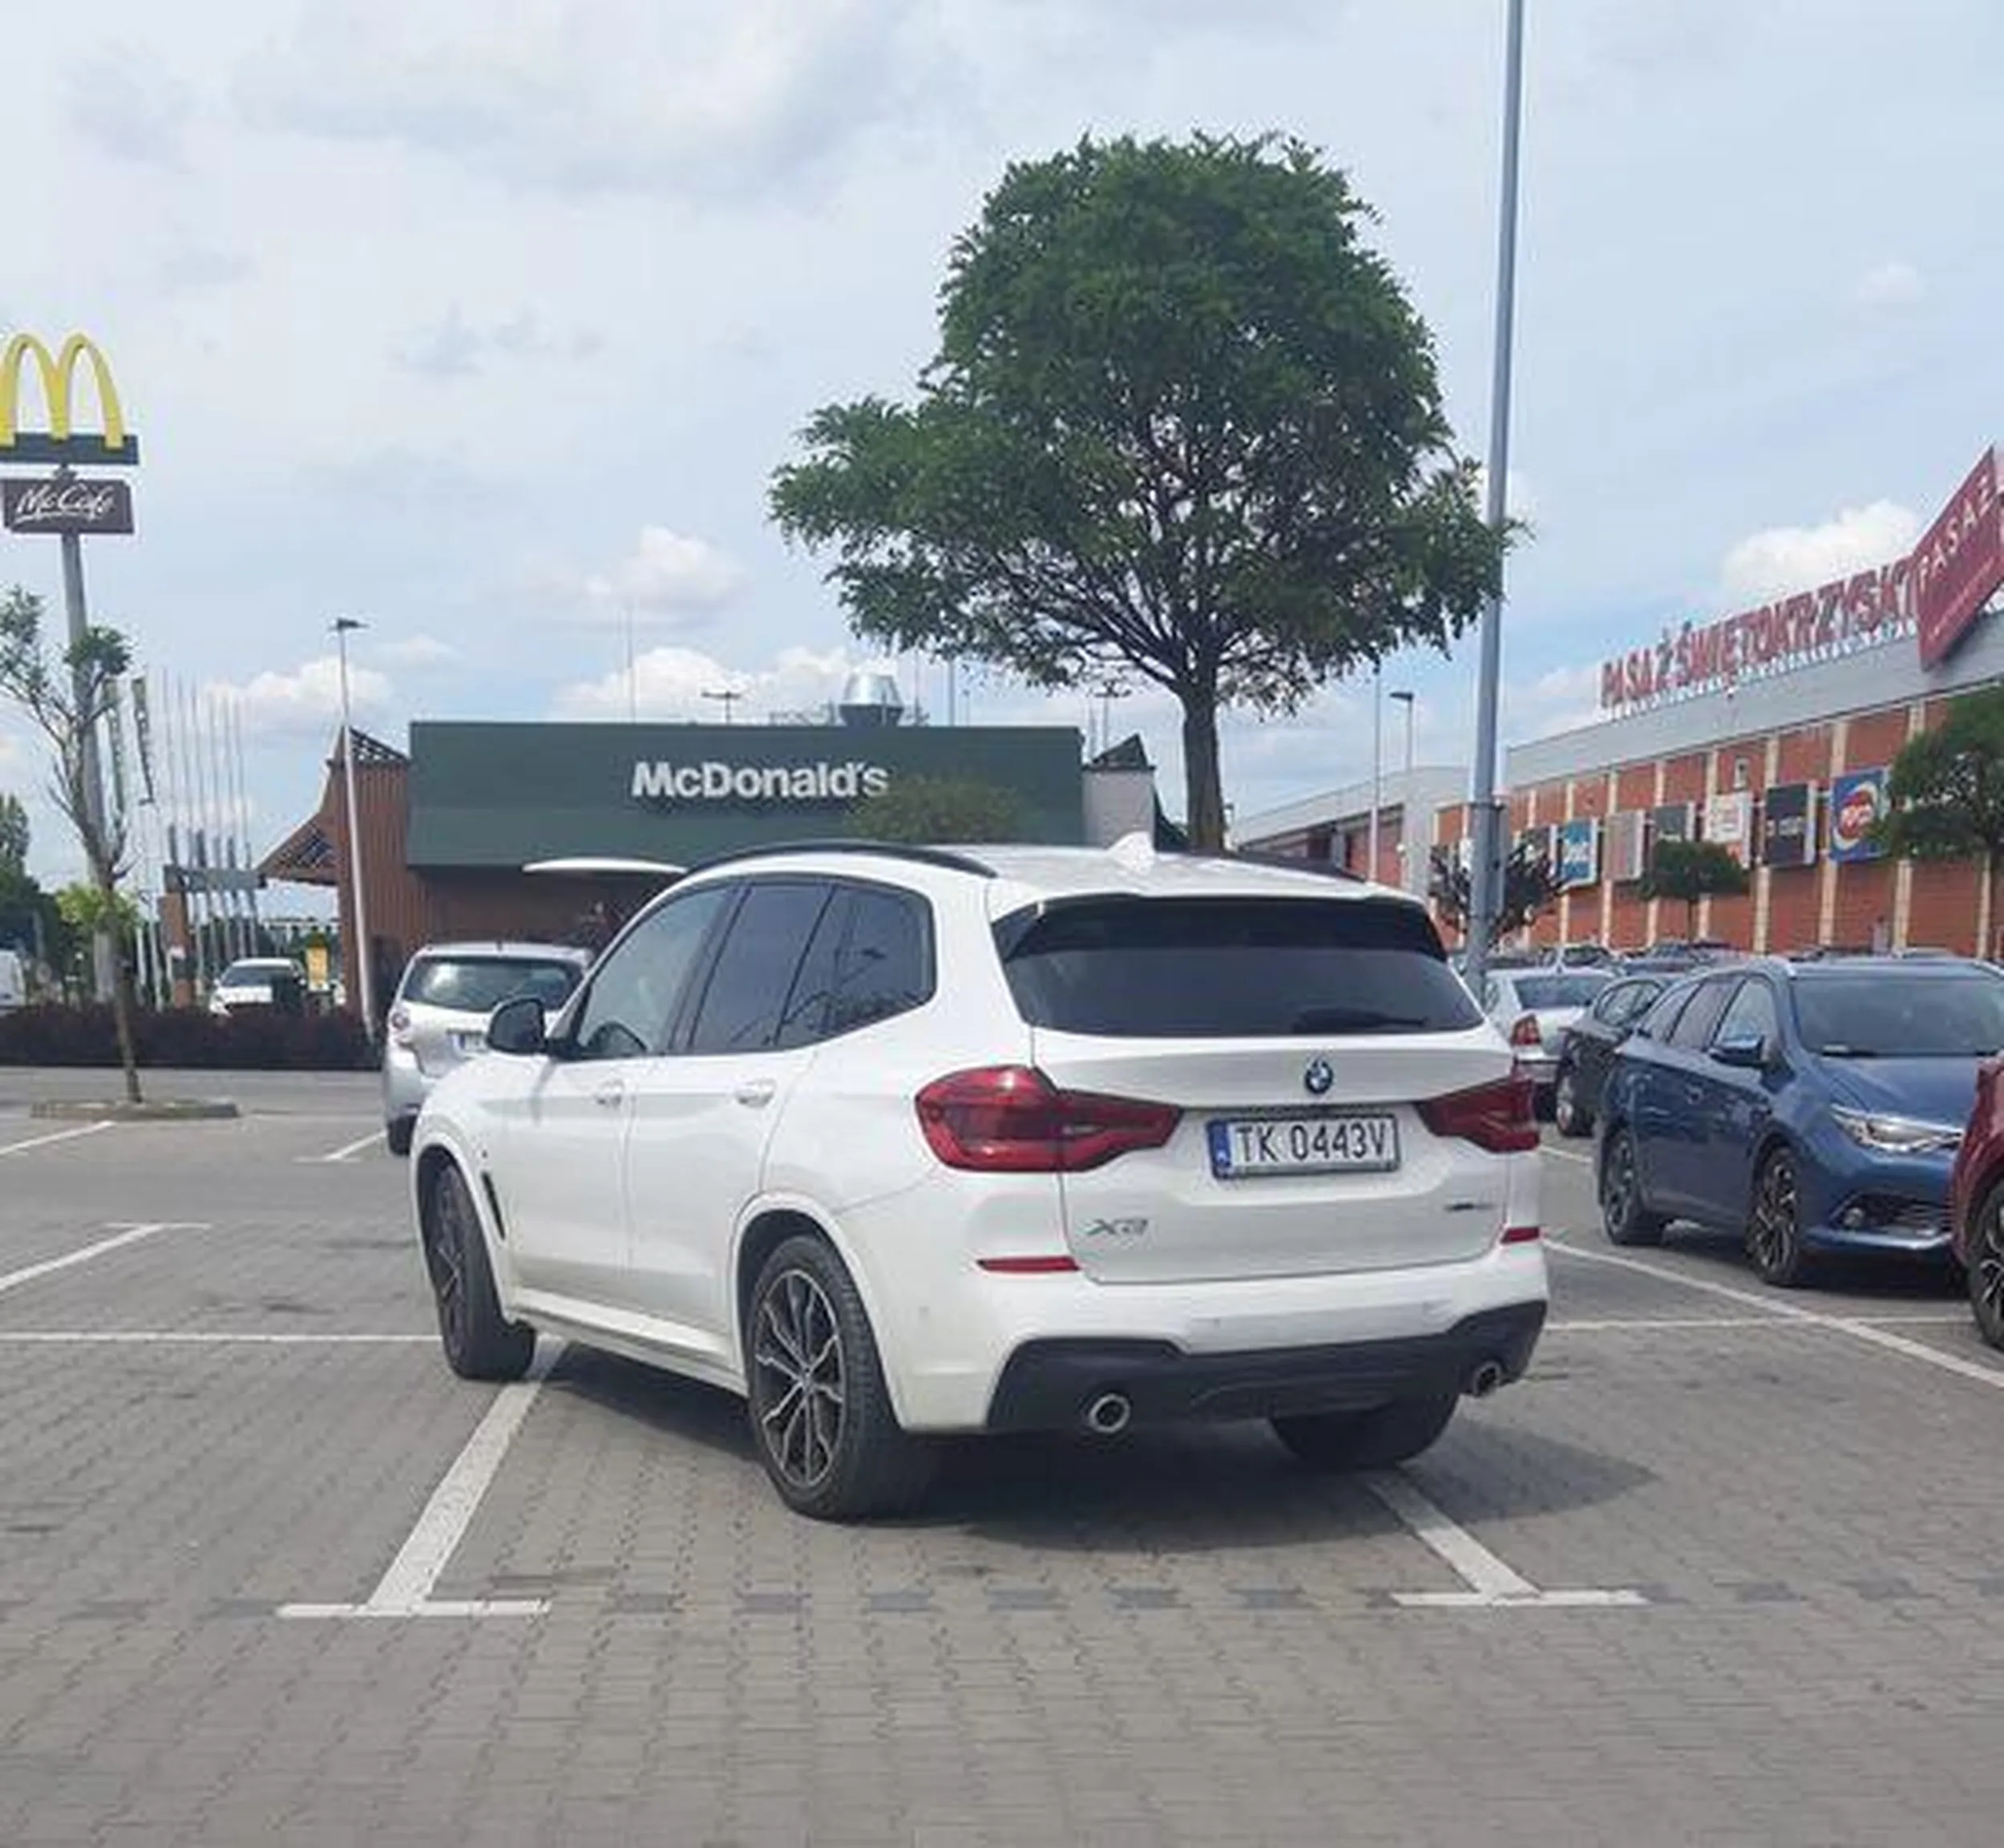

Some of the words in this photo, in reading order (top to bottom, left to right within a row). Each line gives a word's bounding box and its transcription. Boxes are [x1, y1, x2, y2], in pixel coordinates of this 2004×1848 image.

[631, 761, 889, 799] McDonald's
[1234, 1126, 1279, 1163] TK
[1290, 1122, 1388, 1162] 0443V
